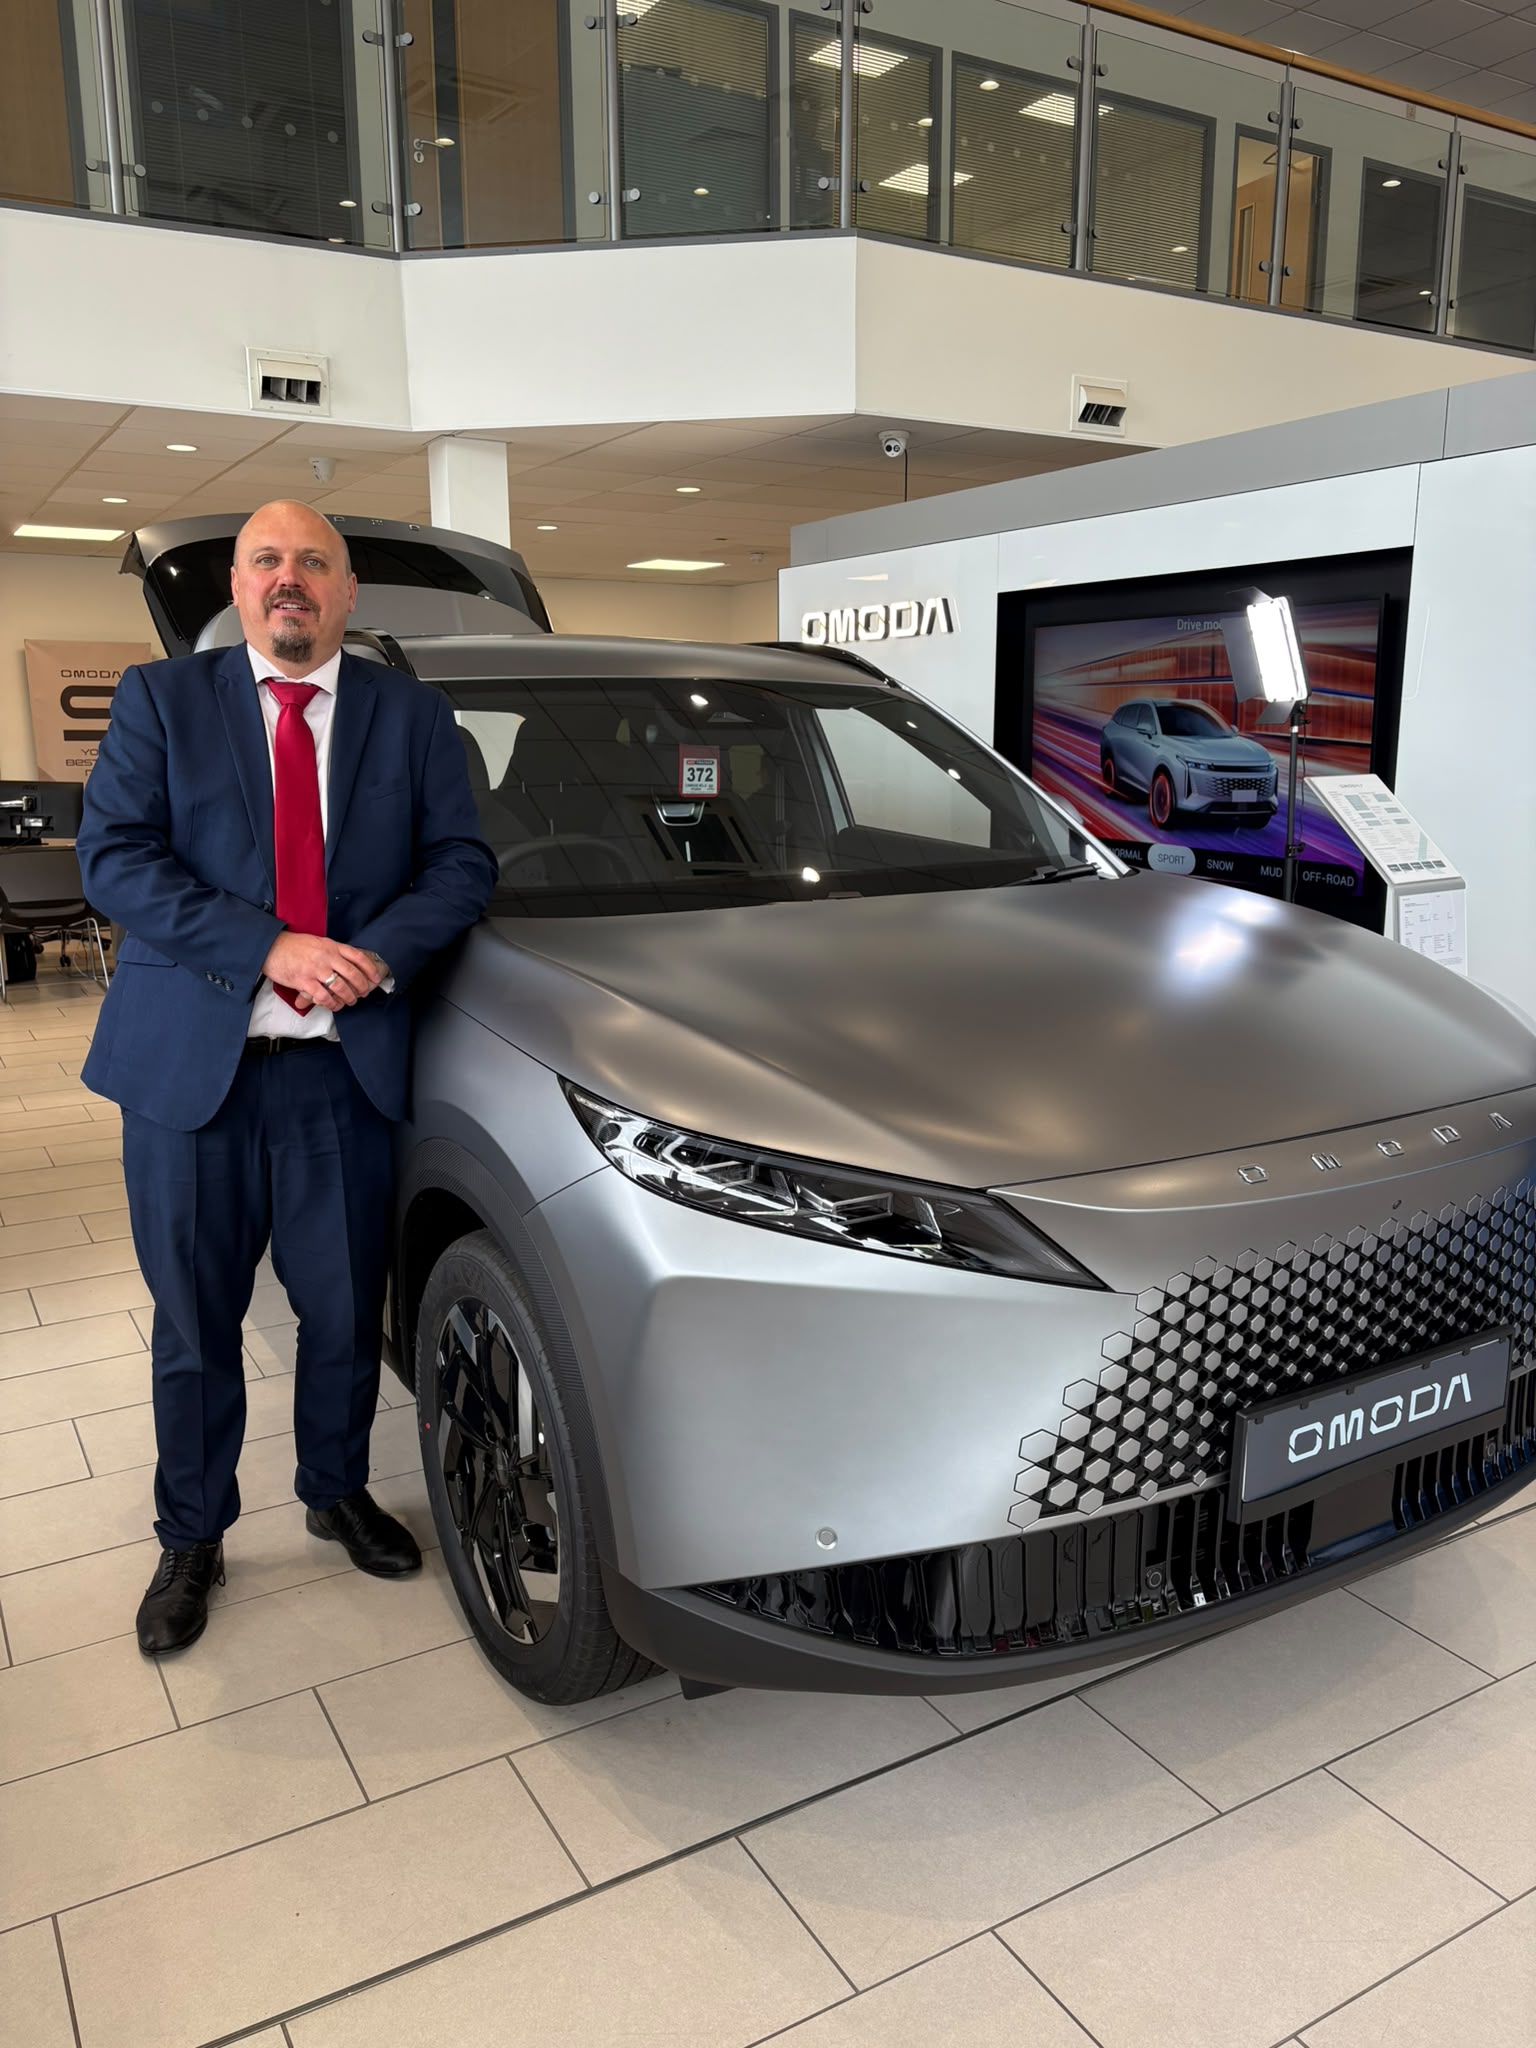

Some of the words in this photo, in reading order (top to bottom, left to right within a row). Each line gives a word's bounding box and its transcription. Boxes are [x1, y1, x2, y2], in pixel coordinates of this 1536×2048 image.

[802, 598, 954, 645] OMODA
[1176, 618, 1201, 631] Drive
[60, 669, 121, 679] OMODA
[81, 748, 99, 756] YO
[687, 767, 714, 782] 372
[1157, 853, 1185, 865] SPORT
[1206, 859, 1234, 872] SNOW
[1260, 865, 1283, 878] MUD
[1302, 871, 1355, 887] OFF-ROAD
[1237, 1112, 1513, 1185] OMODA
[1288, 1373, 1472, 1463] OMODA
